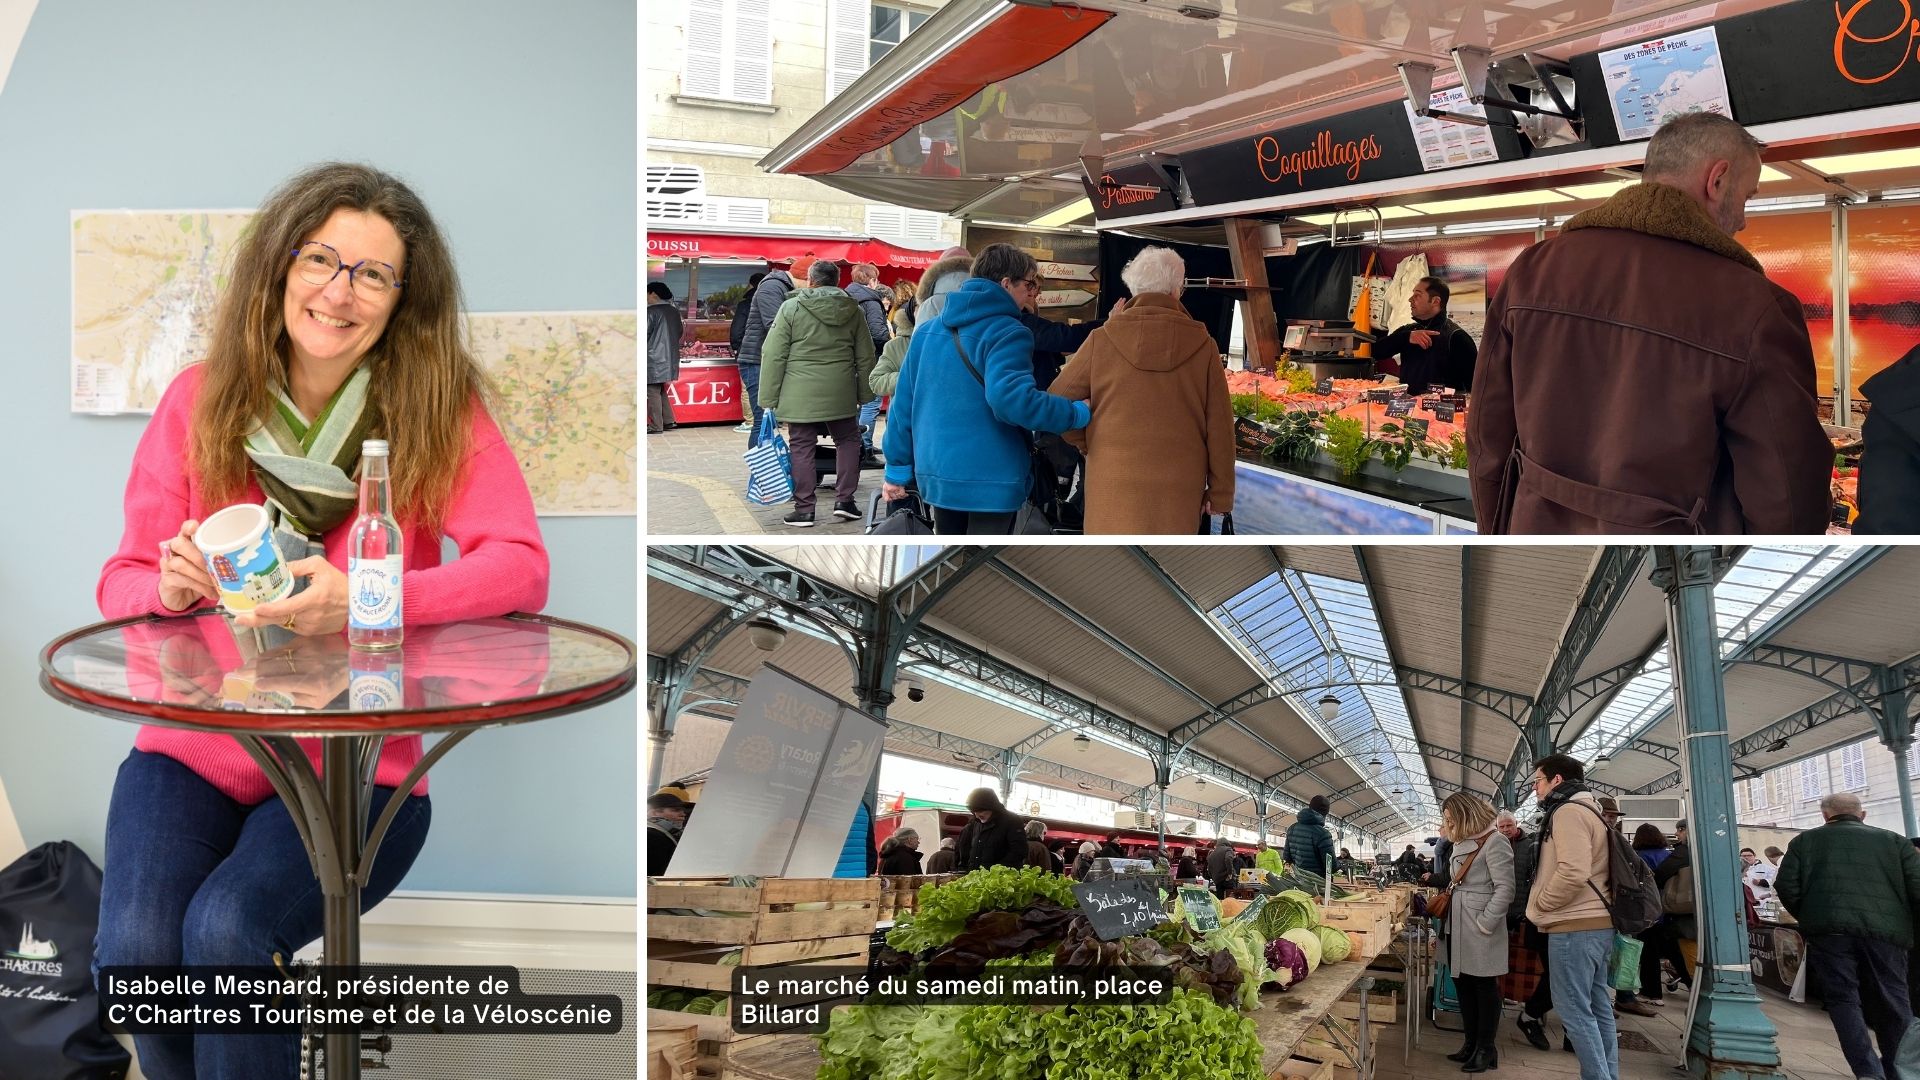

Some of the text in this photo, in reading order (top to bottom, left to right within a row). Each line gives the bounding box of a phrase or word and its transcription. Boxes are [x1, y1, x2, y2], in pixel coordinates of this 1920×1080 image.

[1624, 52, 1636, 61] DES
[1637, 47, 1656, 58] ZONES
[1658, 45, 1667, 53] DE
[1667, 40, 1688, 51] PÊCHE
[1254, 130, 1382, 187] Coquillages
[647, 239, 700, 251] oussu
